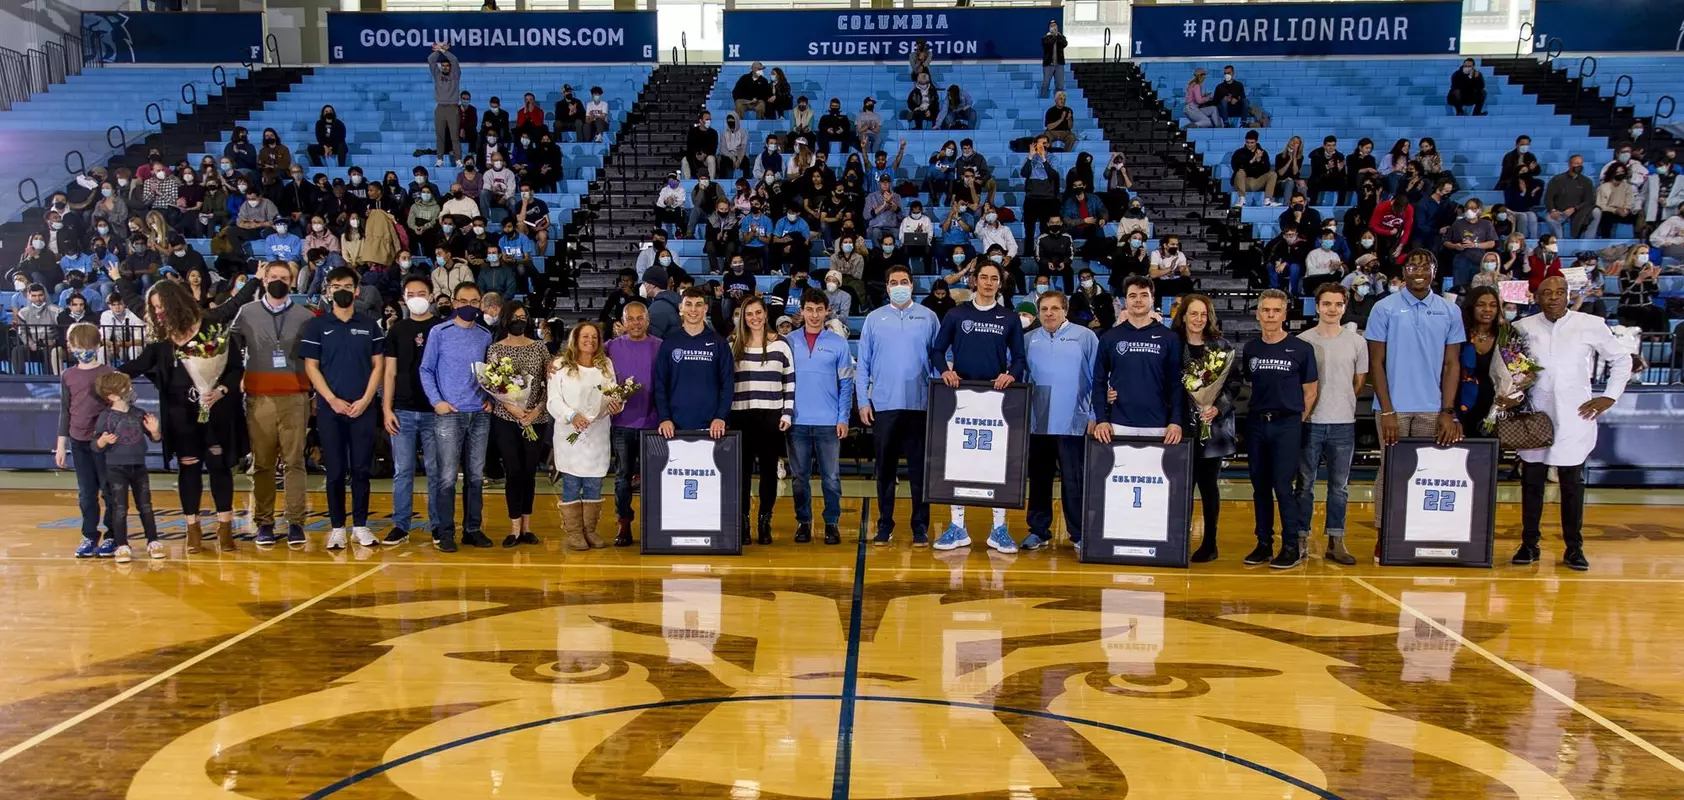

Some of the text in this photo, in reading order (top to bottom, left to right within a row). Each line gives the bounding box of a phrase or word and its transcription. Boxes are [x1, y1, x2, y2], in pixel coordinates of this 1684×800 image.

[837, 14, 949, 30] COLUMBIA
[360, 27, 624, 47] GOCOLUMBIALIONS.COM
[1449, 37, 1456, 51] I
[1536, 34, 1547, 48] J
[250, 46, 260, 58] F
[334, 46, 344, 58] G
[643, 44, 652, 58] G
[728, 44, 740, 58] H
[808, 41, 893, 56] STUDENT
[1135, 41, 1142, 54] I
[973, 322, 1004, 330] COLUMBIA
[954, 417, 1004, 426] COLUMBIA
[962, 428, 992, 450] 32
[667, 468, 716, 476] COLUMBIA
[1112, 475, 1164, 484] COLUMBIA
[1416, 478, 1468, 488] COLUMBIA
[684, 479, 698, 500] 2
[1132, 486, 1142, 508] 1
[1423, 490, 1456, 512] 22
